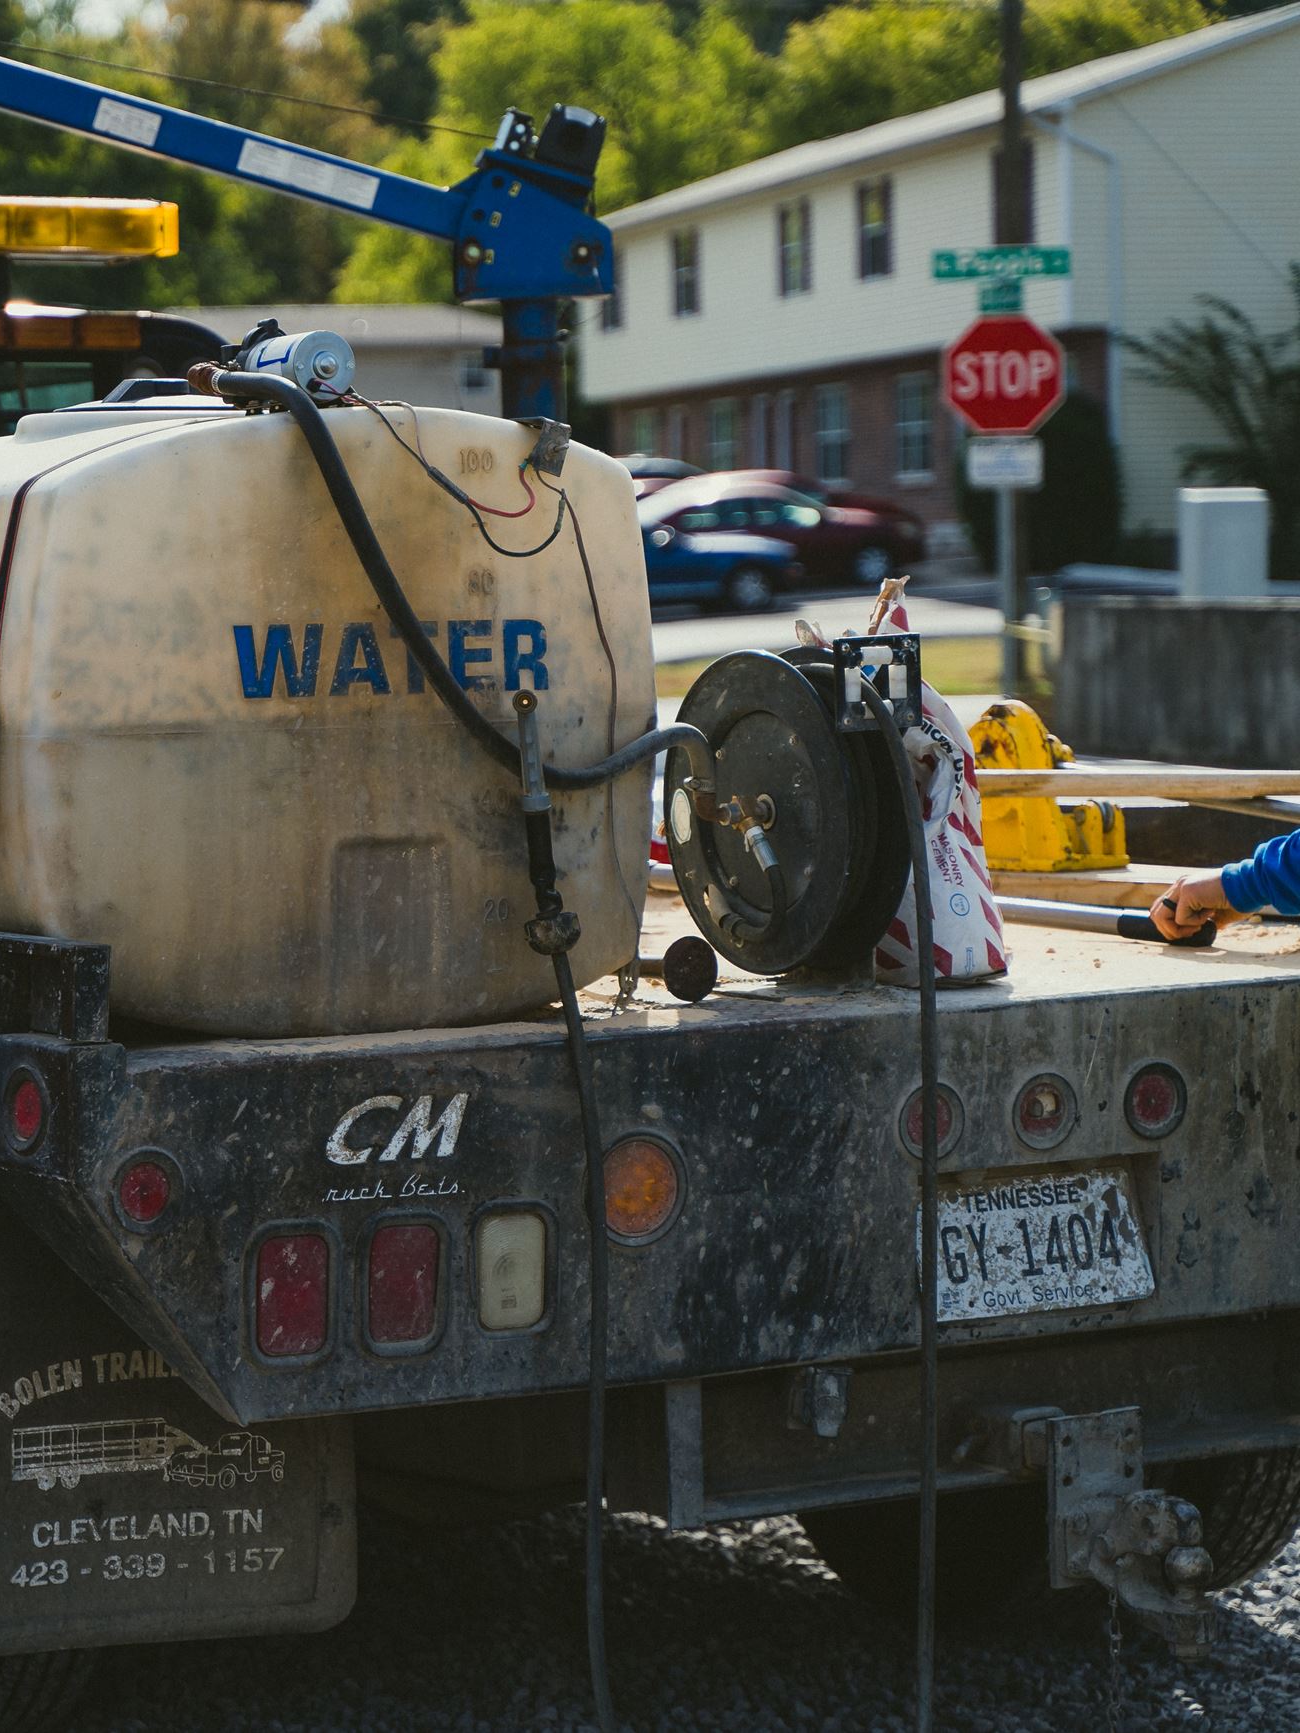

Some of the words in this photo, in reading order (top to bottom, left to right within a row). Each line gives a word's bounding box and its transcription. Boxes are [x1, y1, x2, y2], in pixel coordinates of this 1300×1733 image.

[953, 350, 1053, 400] STOP
[460, 448, 493, 474] 100
[233, 619, 549, 698] WATER
[931, 839, 952, 884] CEMENT
[936, 832, 964, 888] MASONRY
[483, 896, 509, 924] 20
[326, 1092, 469, 1165] CM
[964, 1183, 1082, 1213] TENNESSEE
[983, 1289, 1027, 1308] Govt.
[1032, 1284, 1093, 1303] Service
[91, 1349, 182, 1384] TRAIL
[32, 1511, 215, 1548] CLEVELAND,
[222, 1508, 263, 1535] TN
